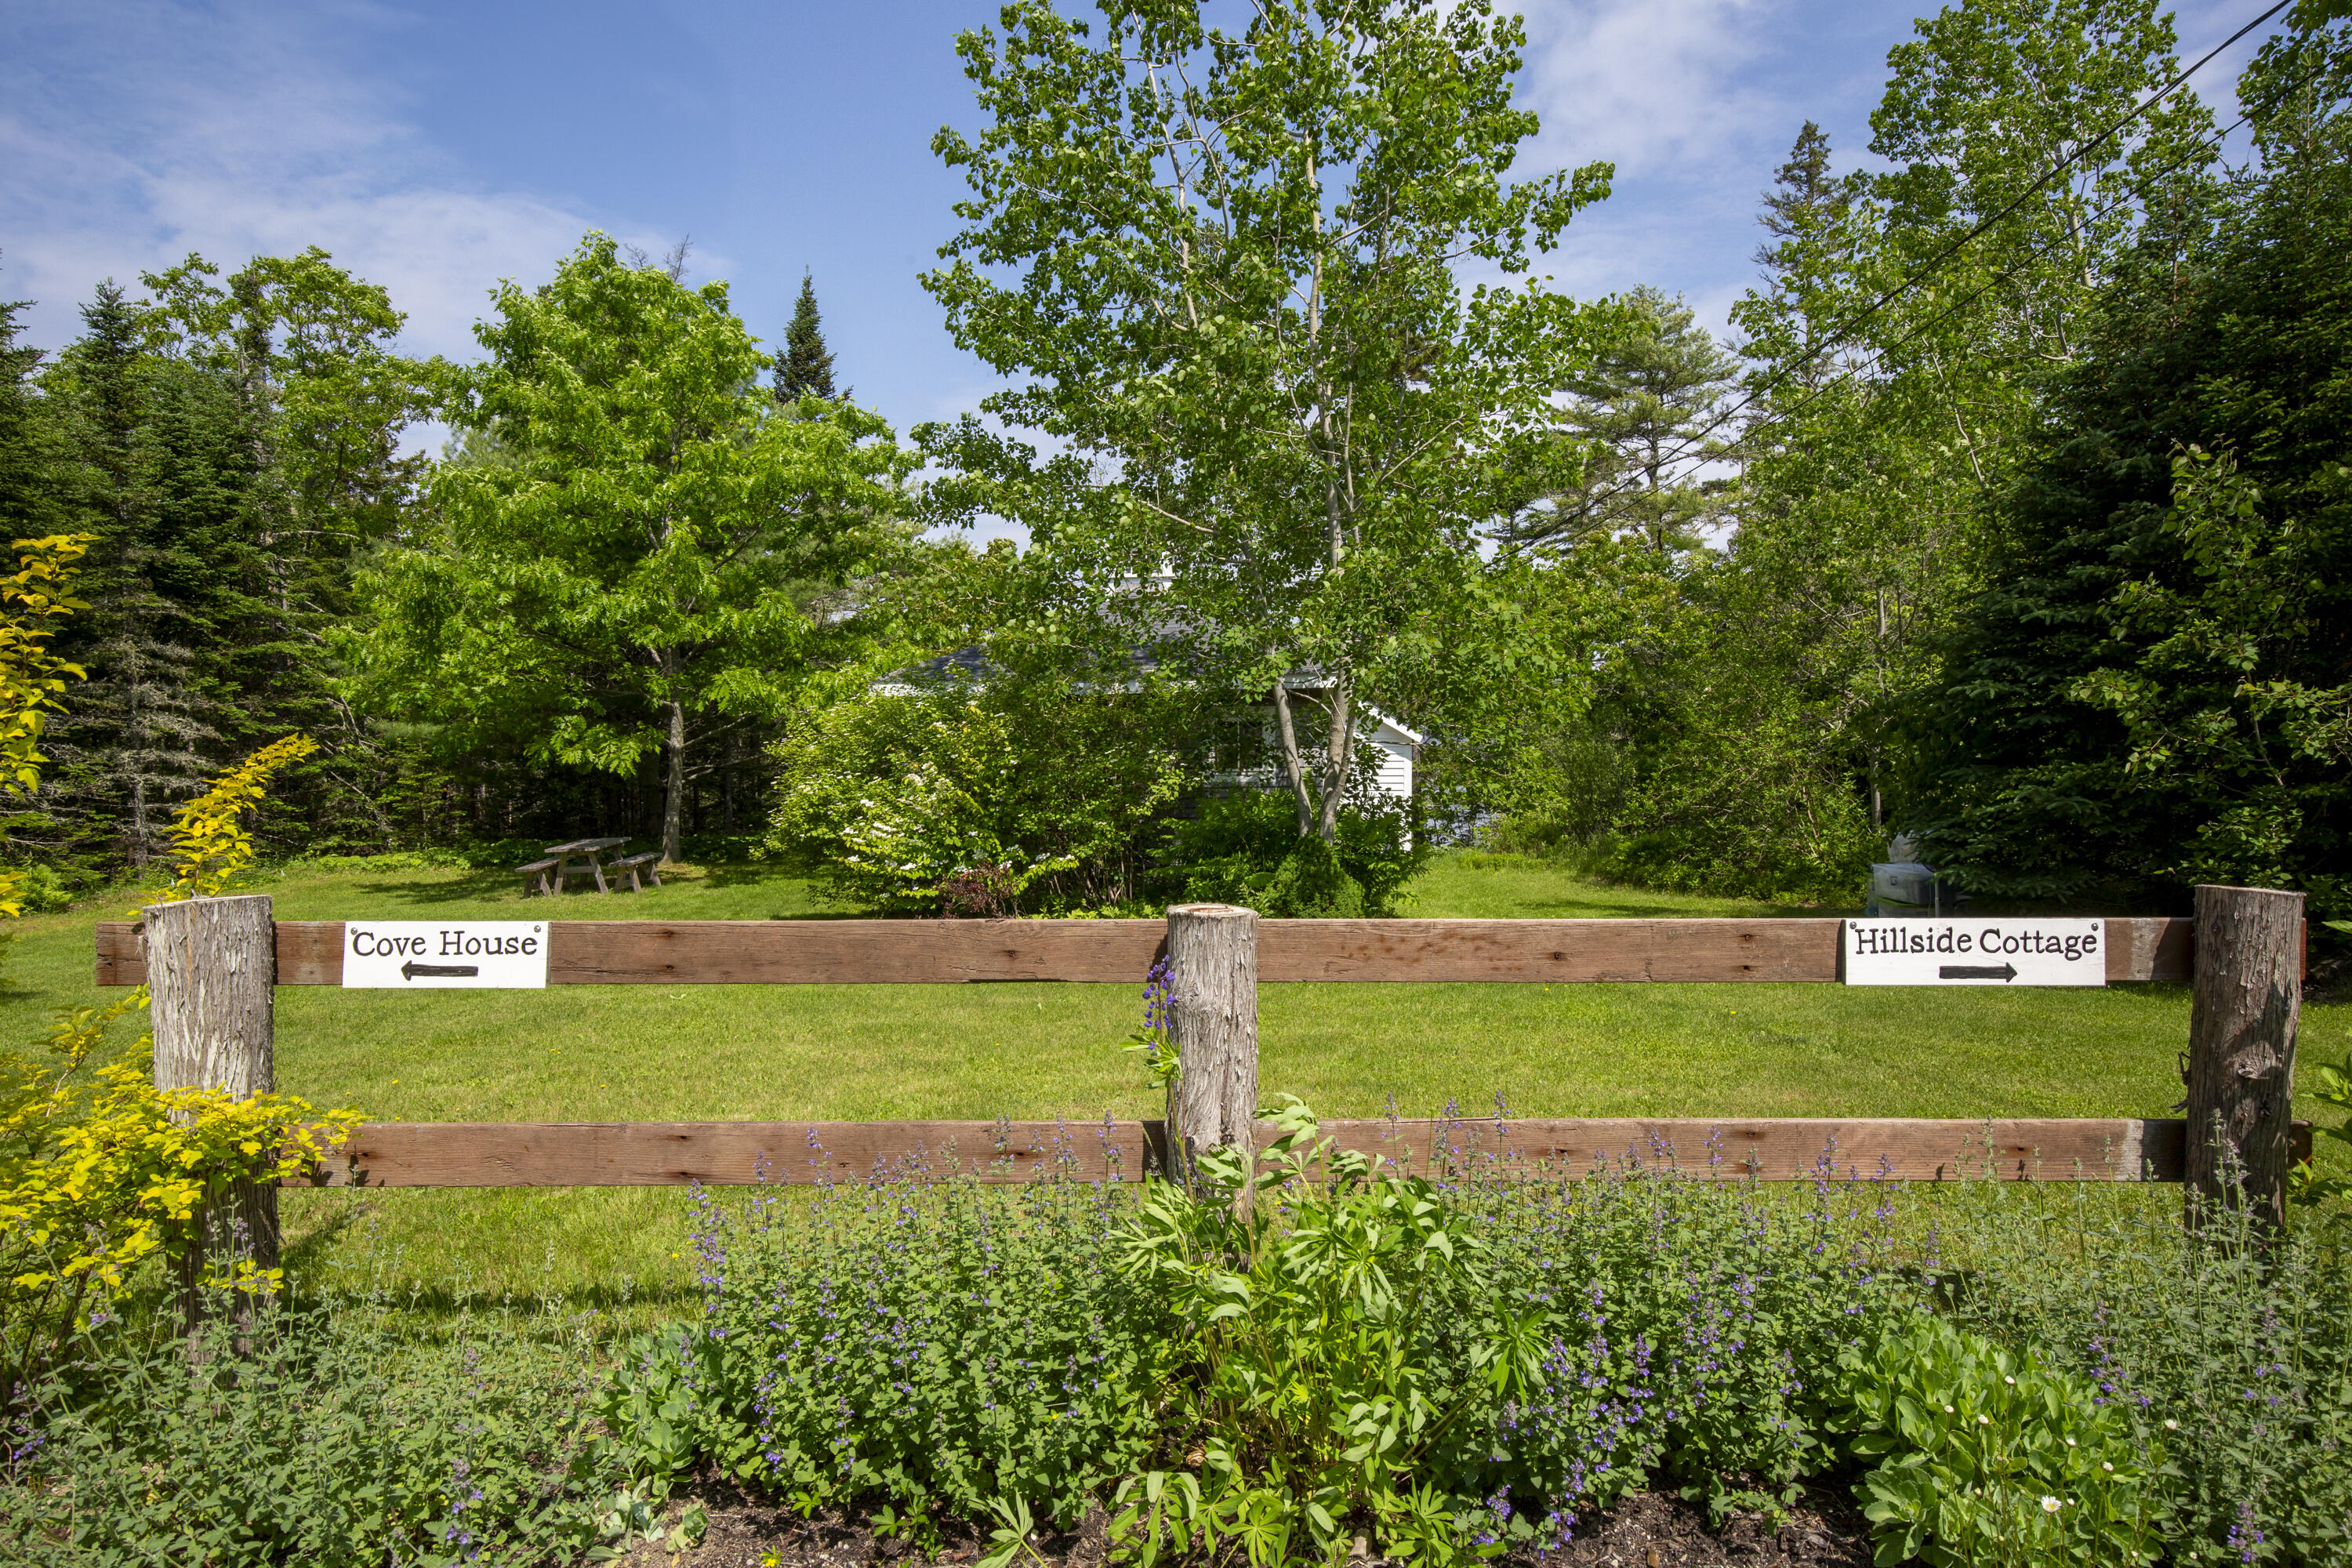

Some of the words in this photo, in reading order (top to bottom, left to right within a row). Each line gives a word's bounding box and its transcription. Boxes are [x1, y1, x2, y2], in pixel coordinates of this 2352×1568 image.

[352, 931, 426, 956] Cove
[438, 931, 538, 956] House
[1854, 927, 1973, 955] Hillside
[1980, 928, 2097, 961] Cottage
